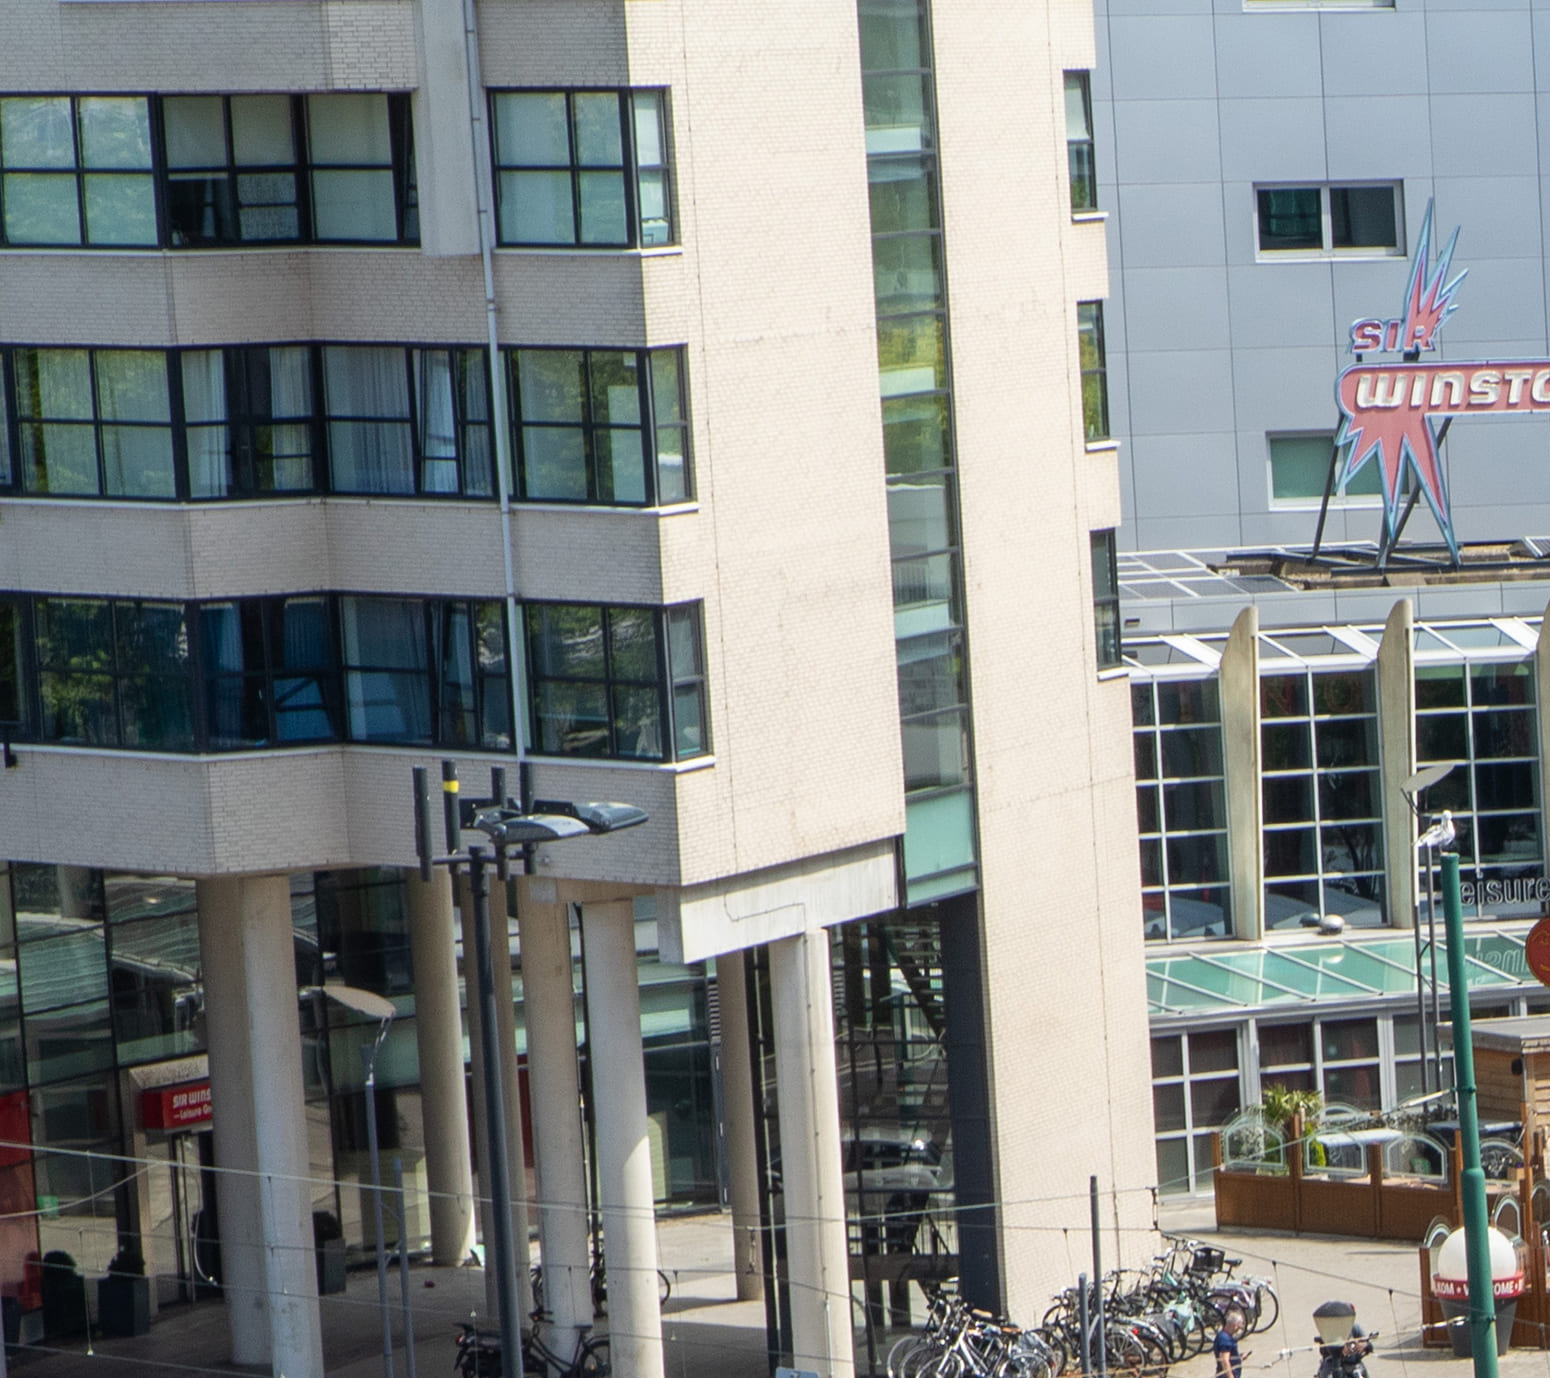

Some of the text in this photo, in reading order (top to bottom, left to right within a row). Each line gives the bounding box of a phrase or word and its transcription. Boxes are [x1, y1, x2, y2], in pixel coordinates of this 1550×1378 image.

[1352, 319, 1436, 351] SIR
[173, 1094, 187, 1109] SIR
[188, 1088, 211, 1105] WINS
